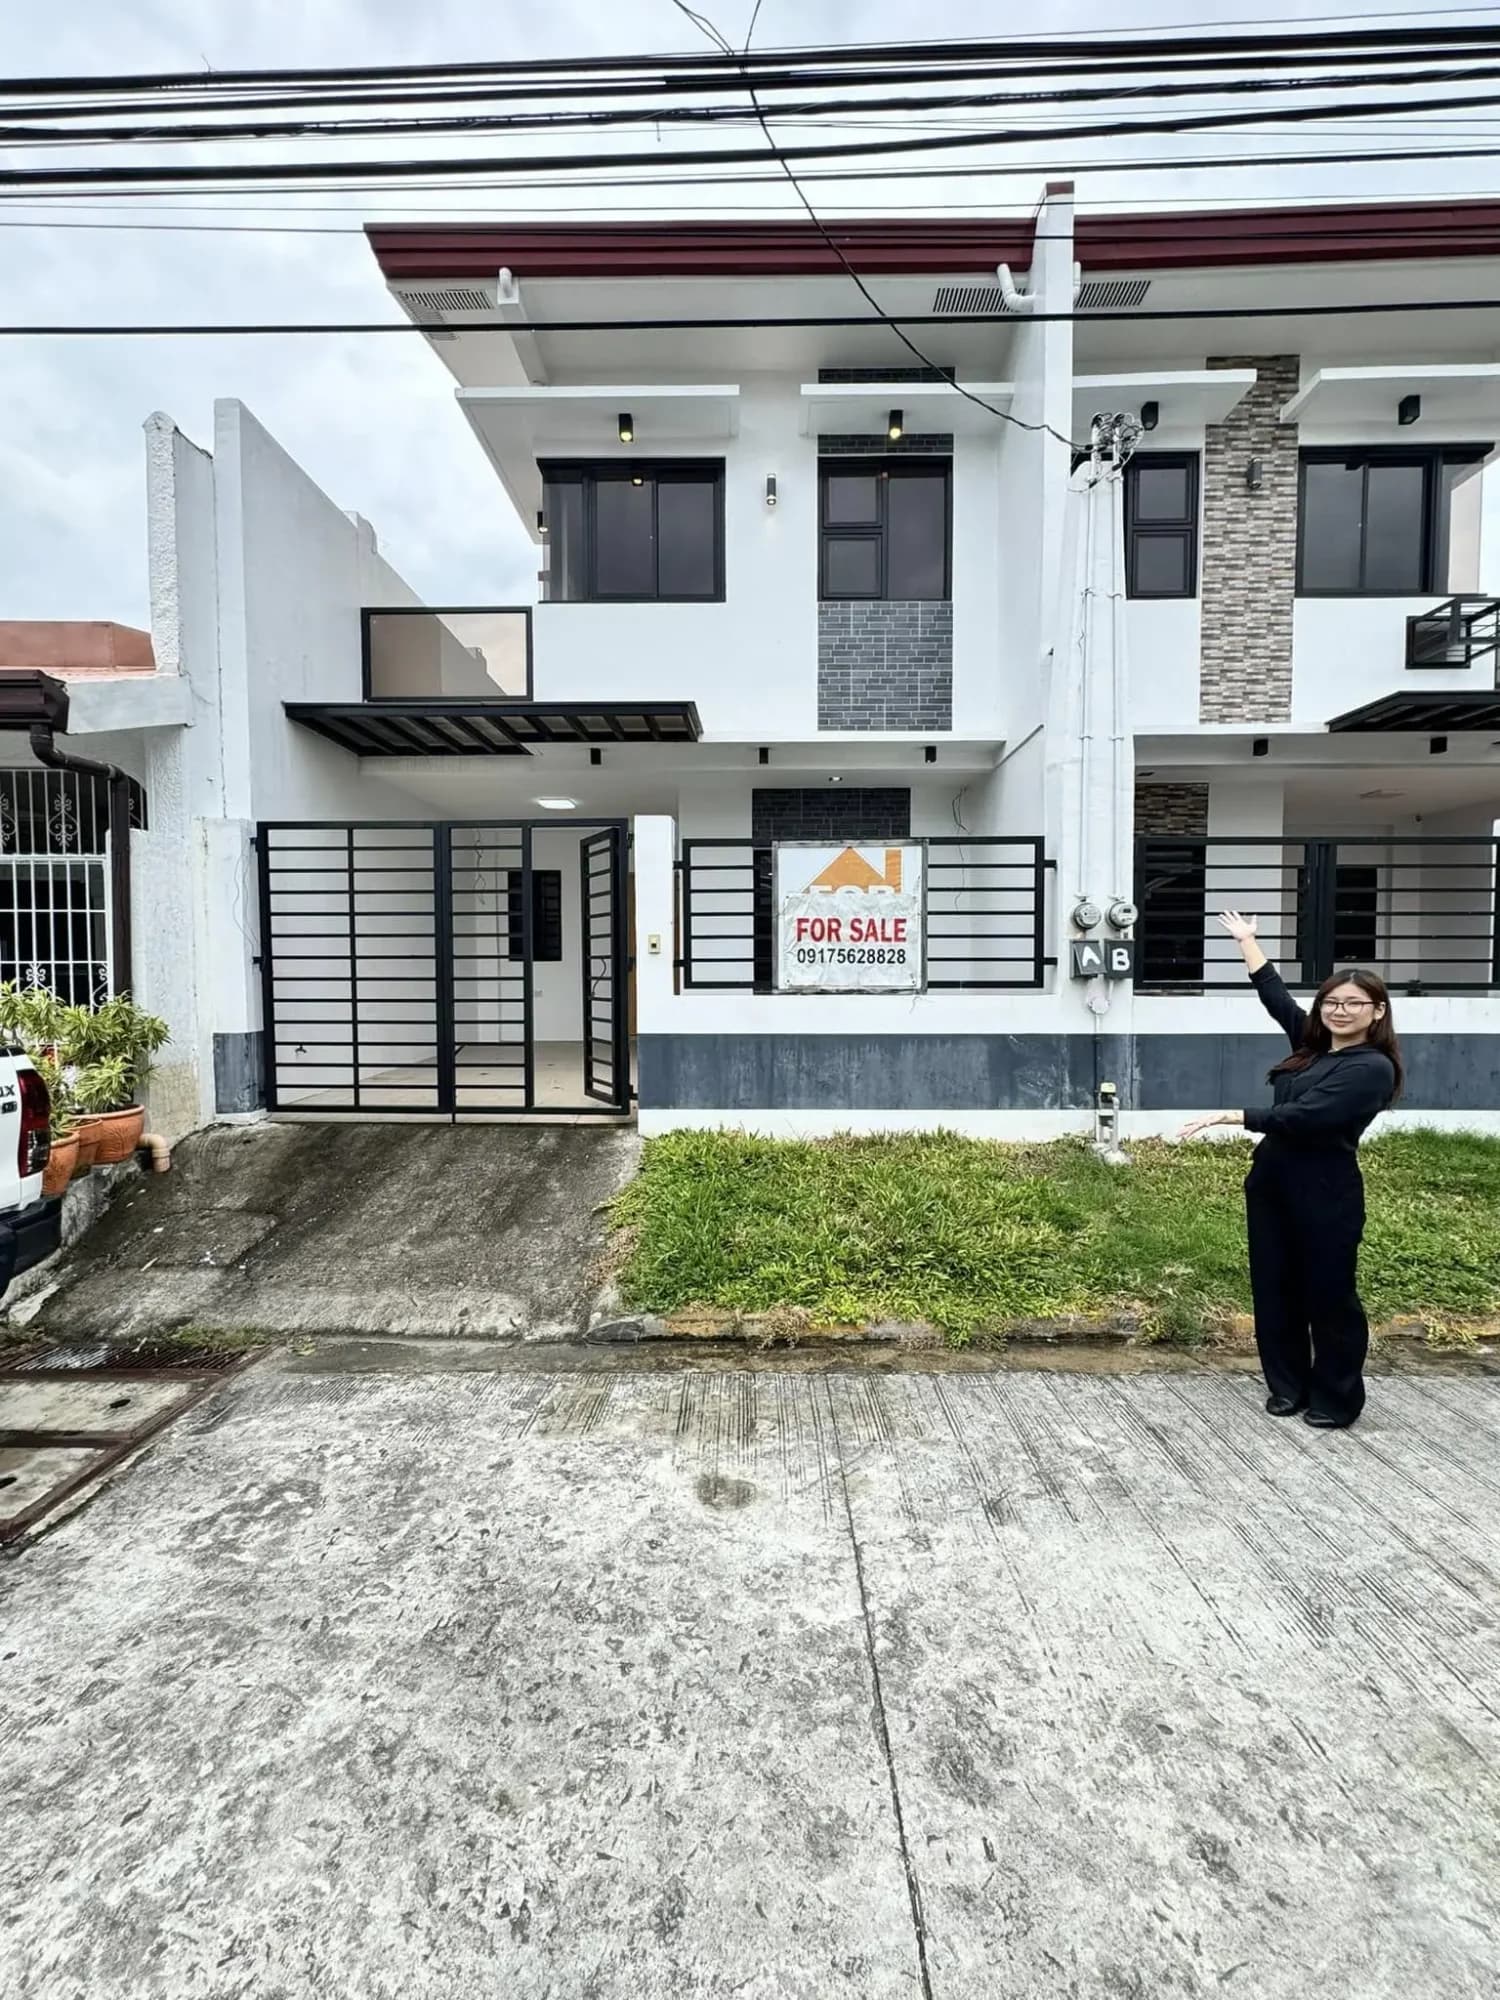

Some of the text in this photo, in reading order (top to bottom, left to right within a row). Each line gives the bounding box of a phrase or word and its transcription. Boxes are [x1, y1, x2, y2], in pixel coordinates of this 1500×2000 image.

[796, 918, 907, 943] FOR SALE
[797, 948, 906, 964] 09175628828
[1082, 945, 1101, 967] A
[1112, 948, 1130, 971] B
